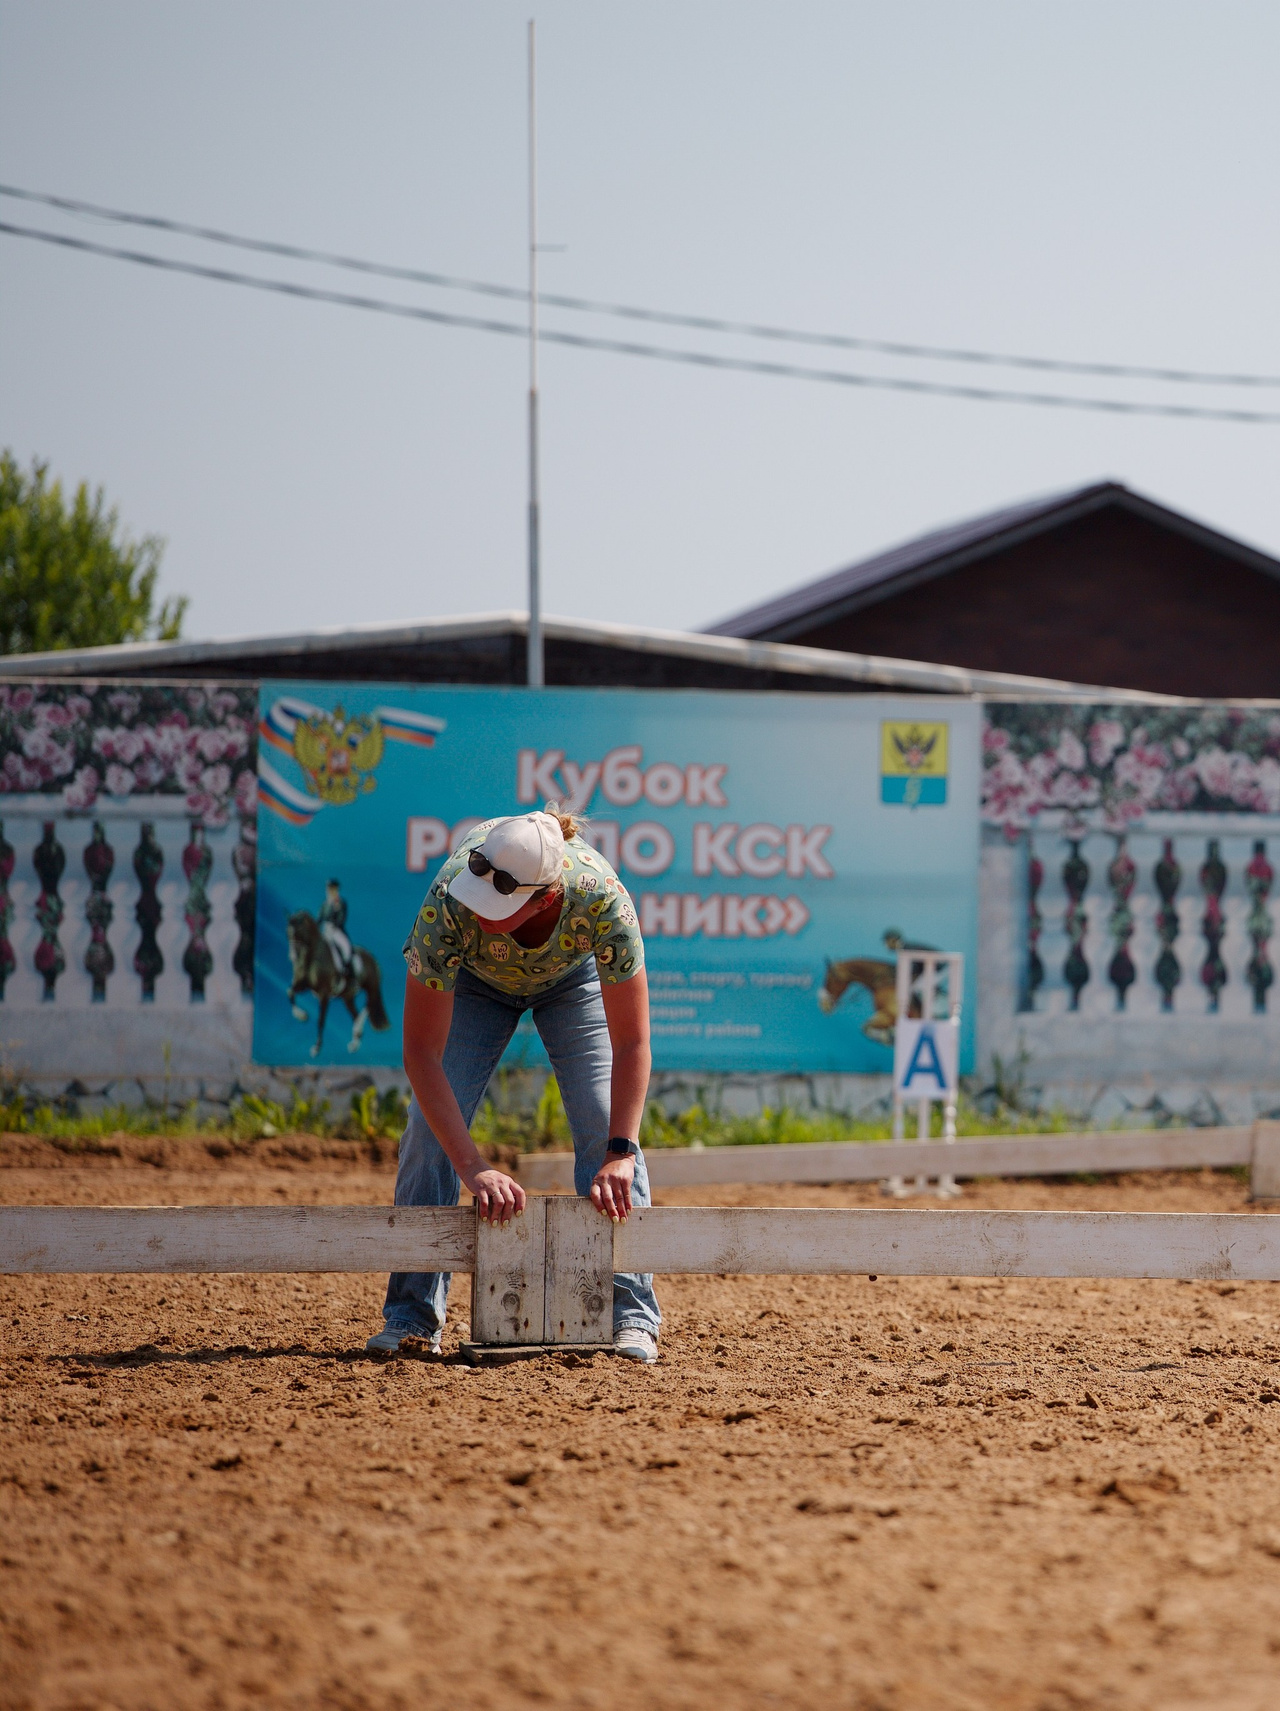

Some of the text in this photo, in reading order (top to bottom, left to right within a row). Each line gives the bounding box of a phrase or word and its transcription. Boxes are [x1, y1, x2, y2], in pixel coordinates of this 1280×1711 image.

[517, 745, 728, 813] Кубок
[693, 821, 834, 880] КСК
[631, 891, 810, 938] НИК»
